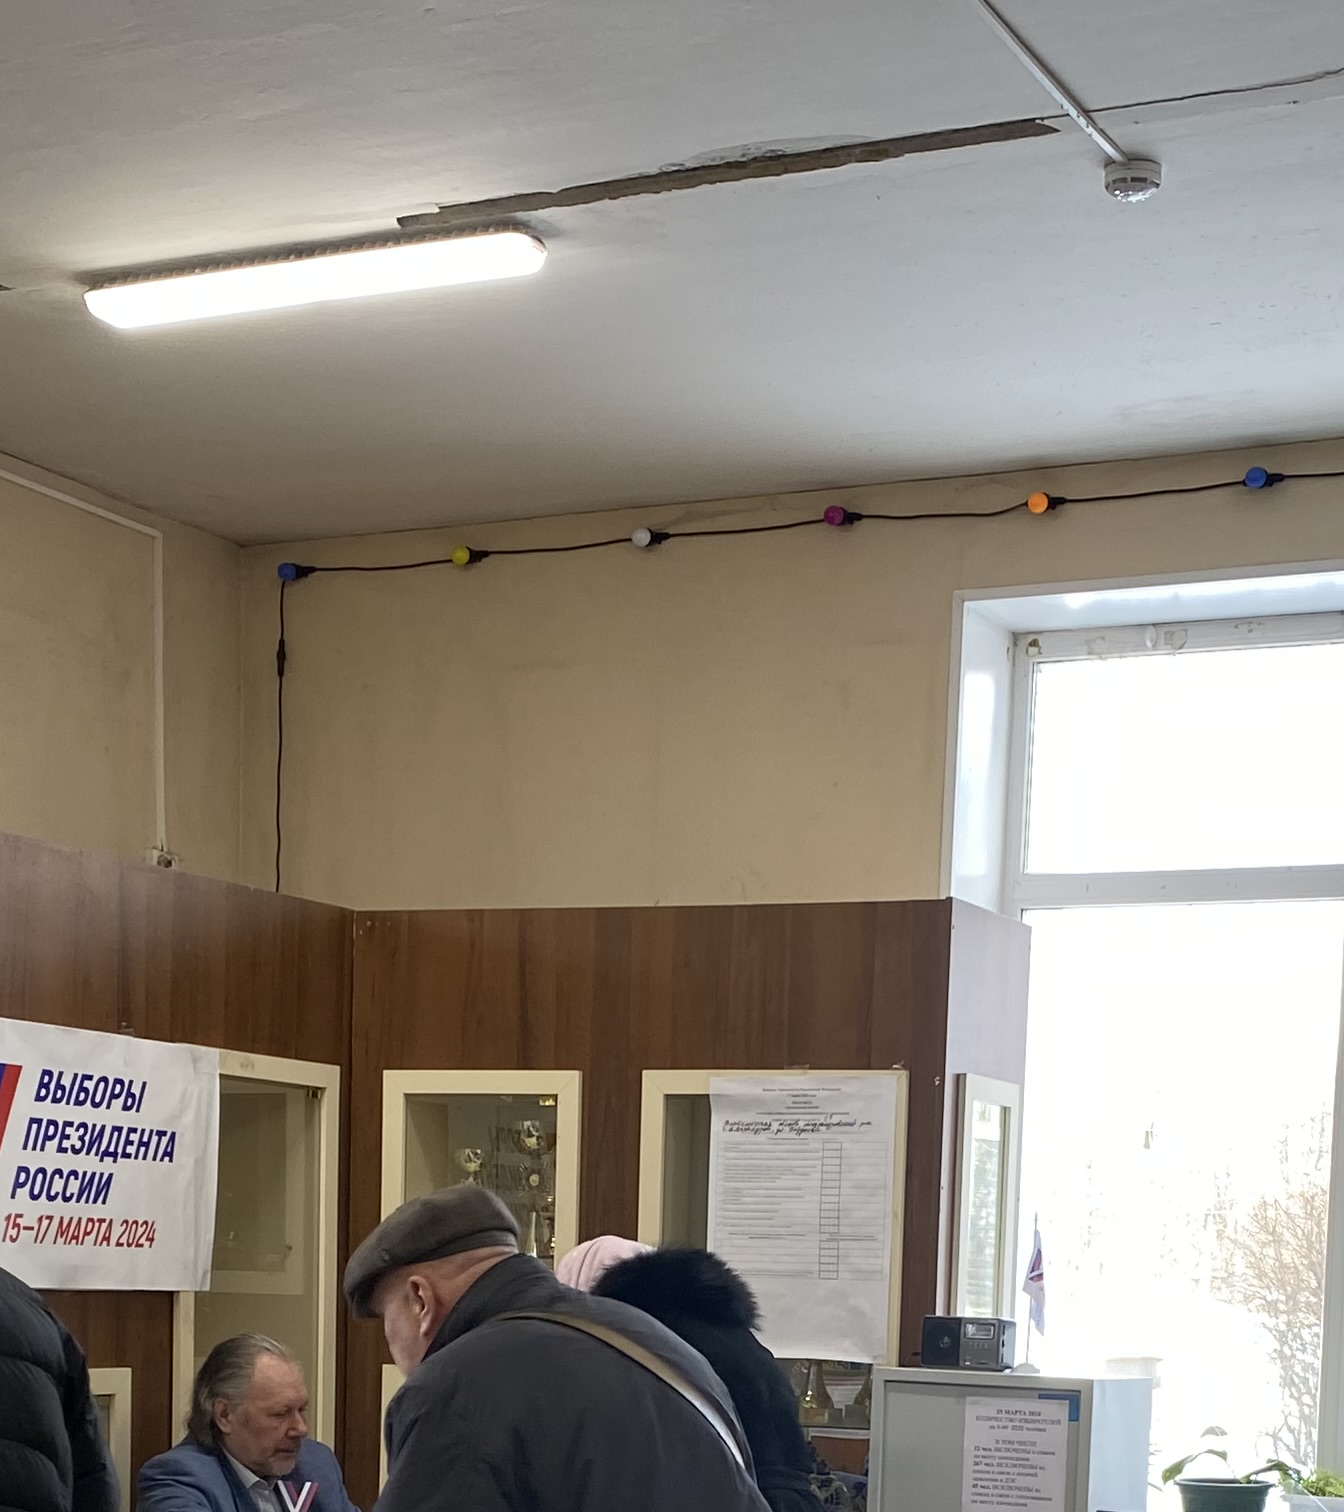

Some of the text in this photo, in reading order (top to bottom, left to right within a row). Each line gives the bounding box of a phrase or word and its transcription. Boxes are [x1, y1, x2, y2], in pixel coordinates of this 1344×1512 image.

[33, 1068, 148, 1113] ВЫБОРЫ
[21, 1117, 177, 1164] ПРЕЗИДЕНТА
[10, 1165, 114, 1205] РОССИИ
[53, 1216, 112, 1248] МАРТА
[114, 1219, 156, 1249] 2024
